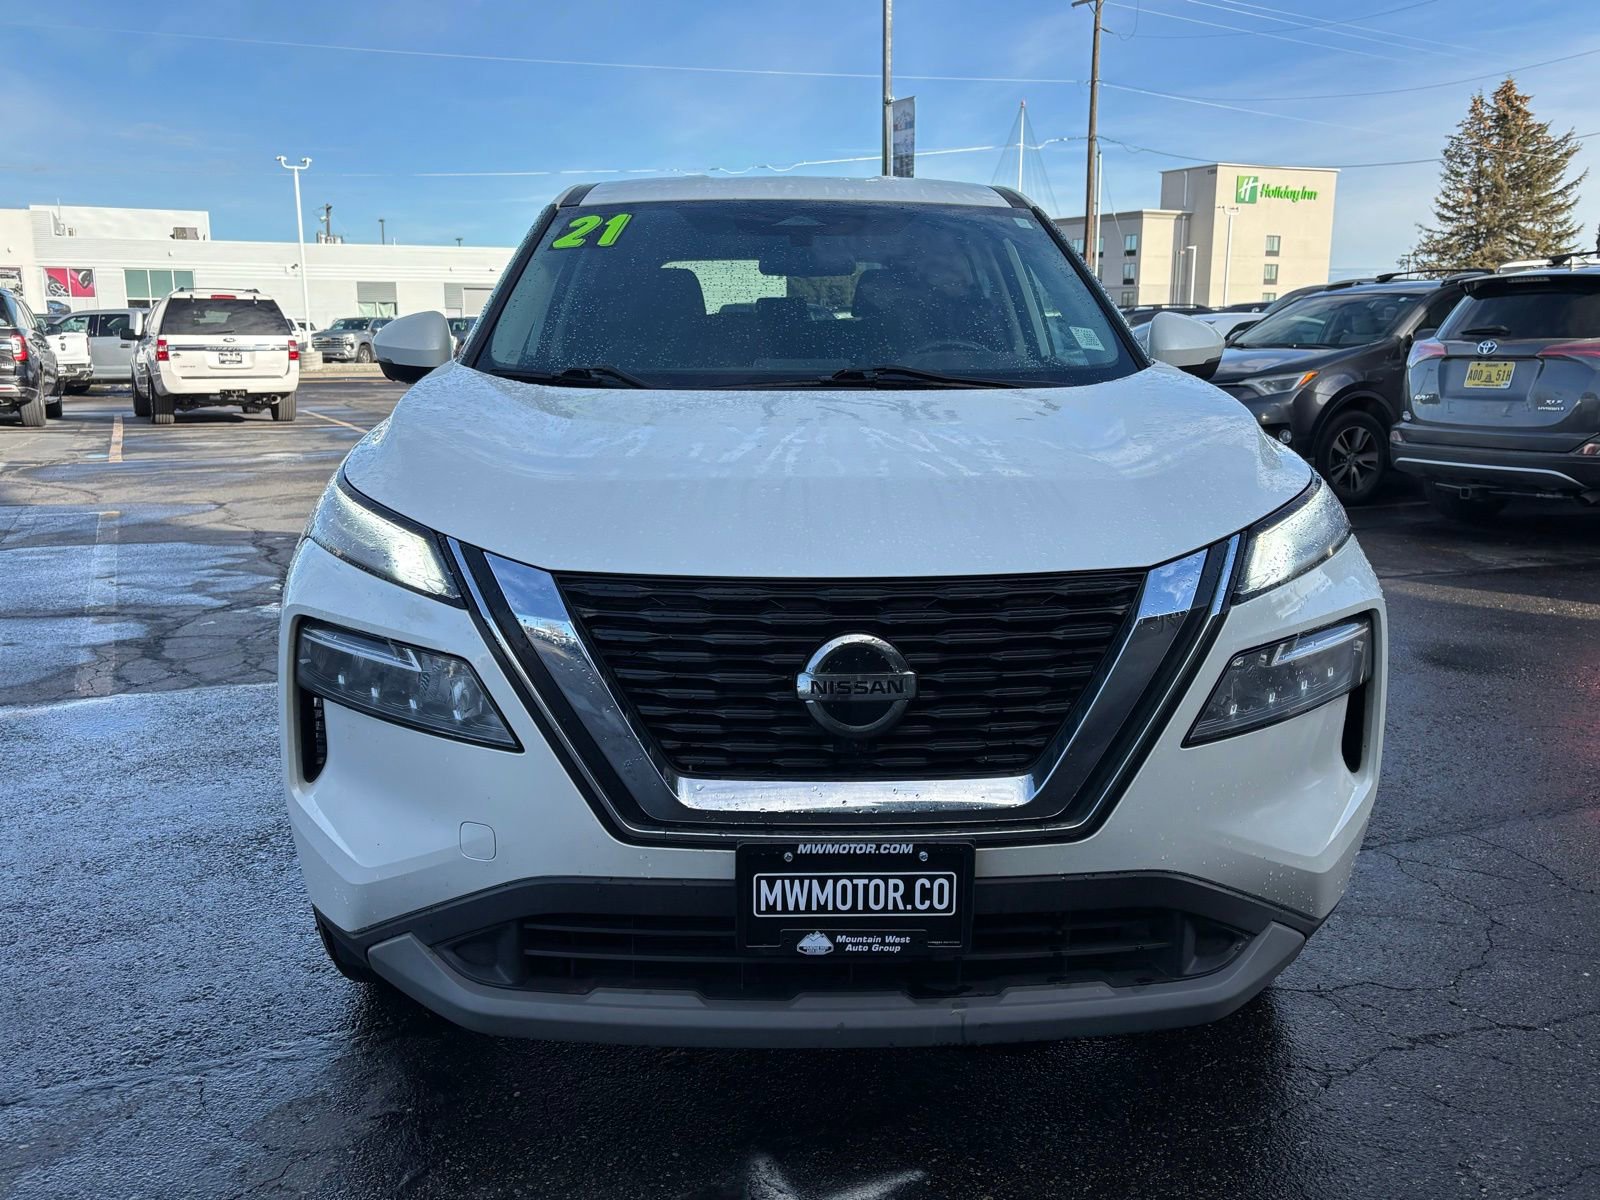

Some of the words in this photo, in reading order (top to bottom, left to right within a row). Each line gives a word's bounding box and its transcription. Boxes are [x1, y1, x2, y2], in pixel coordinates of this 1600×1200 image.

[1260, 184, 1300, 203] Holiday
[1301, 186, 1318, 200] Inn
[552, 213, 632, 248] 21
[810, 680, 904, 694] NISSAN
[797, 843, 914, 854] MWMOTOR.COM
[760, 878, 950, 911] MWMOTOR.CO
[836, 935, 882, 943] Mountain
[885, 935, 911, 943] West
[845, 944, 869, 952] Auto
[871, 944, 901, 954] Group
